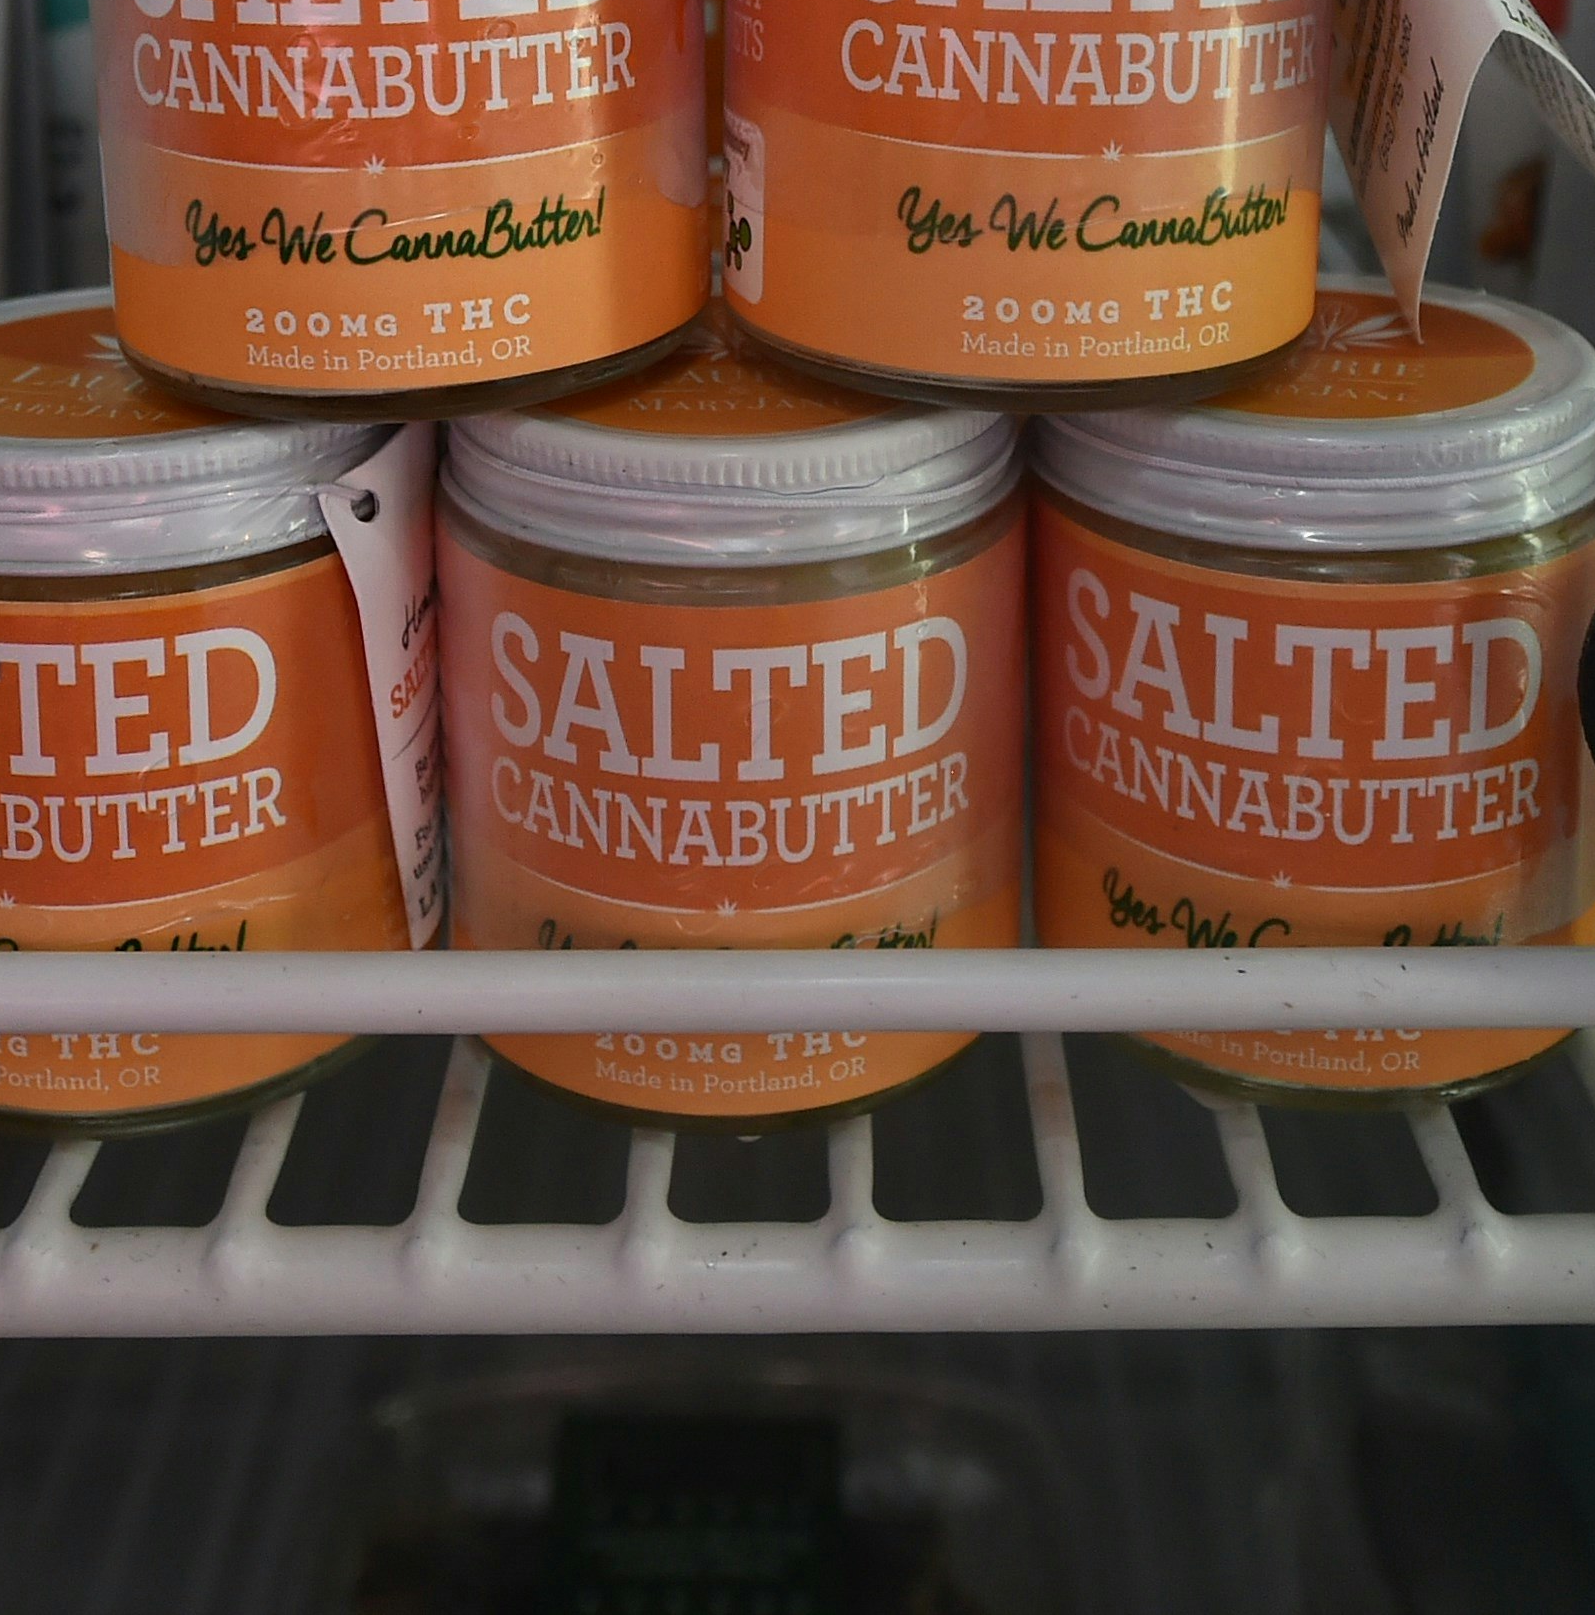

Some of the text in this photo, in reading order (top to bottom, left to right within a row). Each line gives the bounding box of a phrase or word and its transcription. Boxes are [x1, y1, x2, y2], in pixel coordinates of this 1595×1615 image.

[131, 20, 637, 120] CANNABUTTER
[841, 15, 1318, 108] CANNABUTTER
[184, 185, 607, 267] Yes We CannaButter!
[896, 176, 1293, 255] Yes We CannaButter!
[244, 294, 533, 337] 200MG THC
[960, 322, 1231, 360] Made in Portland, OR
[962, 280, 1234, 325] 200MG THC
[245, 334, 533, 373] Made in Portland, OR
[491, 610, 970, 782] SALTED
[1065, 567, 1544, 762] SALTED
[491, 751, 971, 868] CANNABUTTER
[1063, 706, 1542, 849] CANNABUTTER
[1104, 869, 1167, 936] Yes
[1170, 897, 1239, 949] We
[52, 1033, 161, 1059] THC
[118, 1066, 161, 1089] OR
[595, 1056, 867, 1095] Made in Portland, OR
[1221, 1034, 1245, 1058] in
[1253, 1043, 1373, 1076] Portland,
[1380, 1051, 1421, 1073] OR
